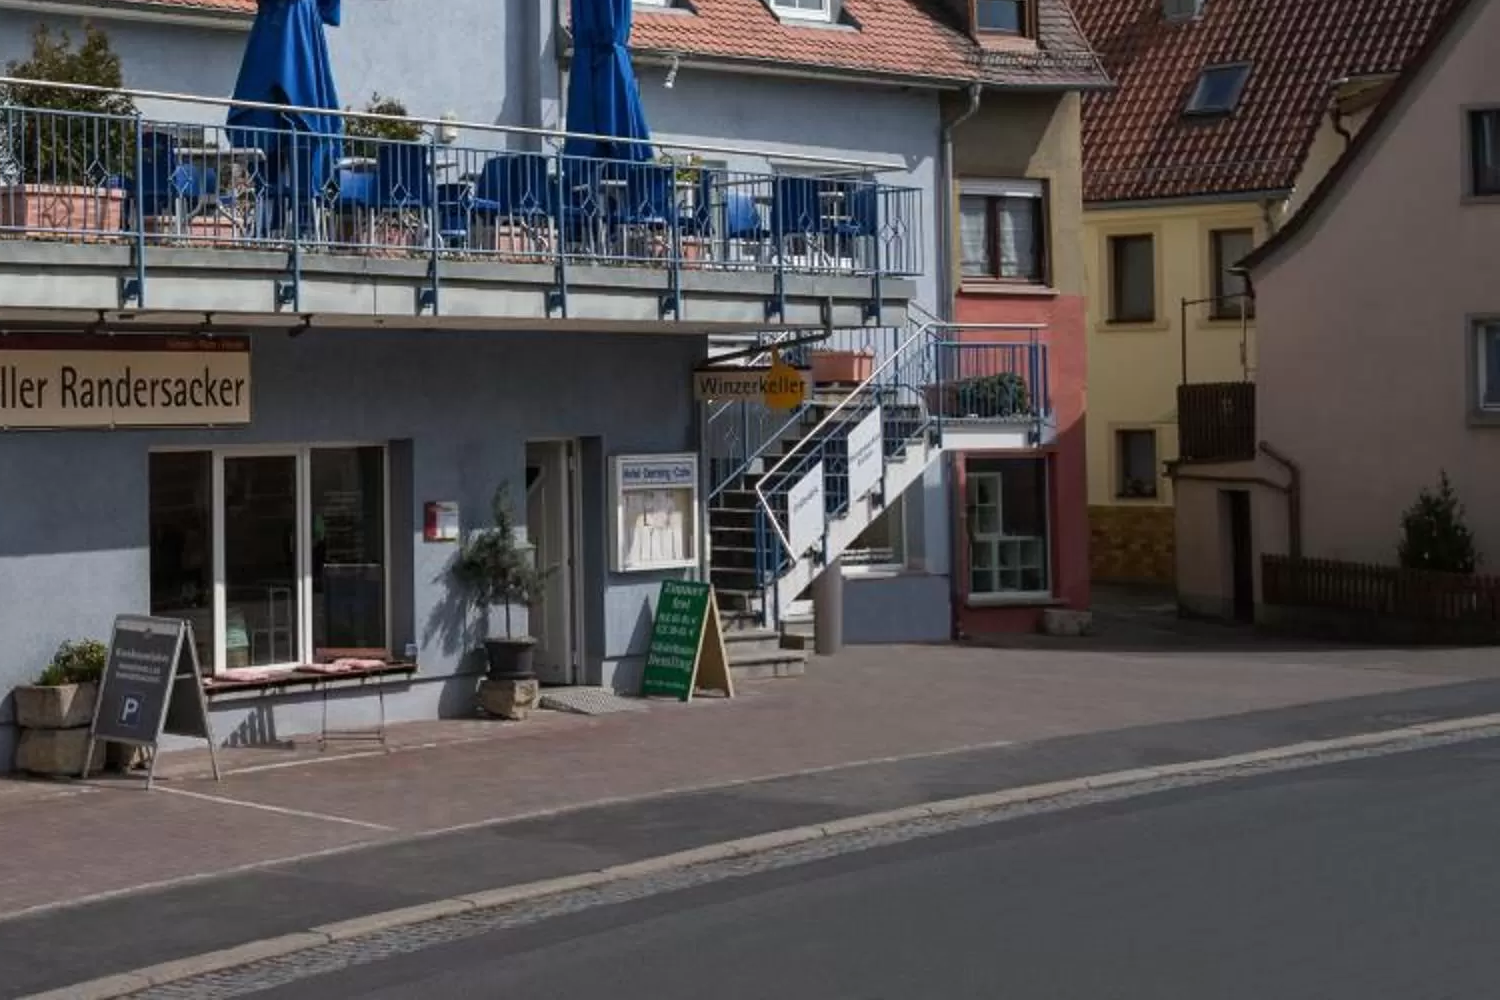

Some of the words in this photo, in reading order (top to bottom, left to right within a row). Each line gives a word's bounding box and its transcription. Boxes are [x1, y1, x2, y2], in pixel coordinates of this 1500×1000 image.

[60, 365, 245, 409] Randersacker
[701, 376, 805, 394] Winzerkeller
[122, 696, 140, 721] P
